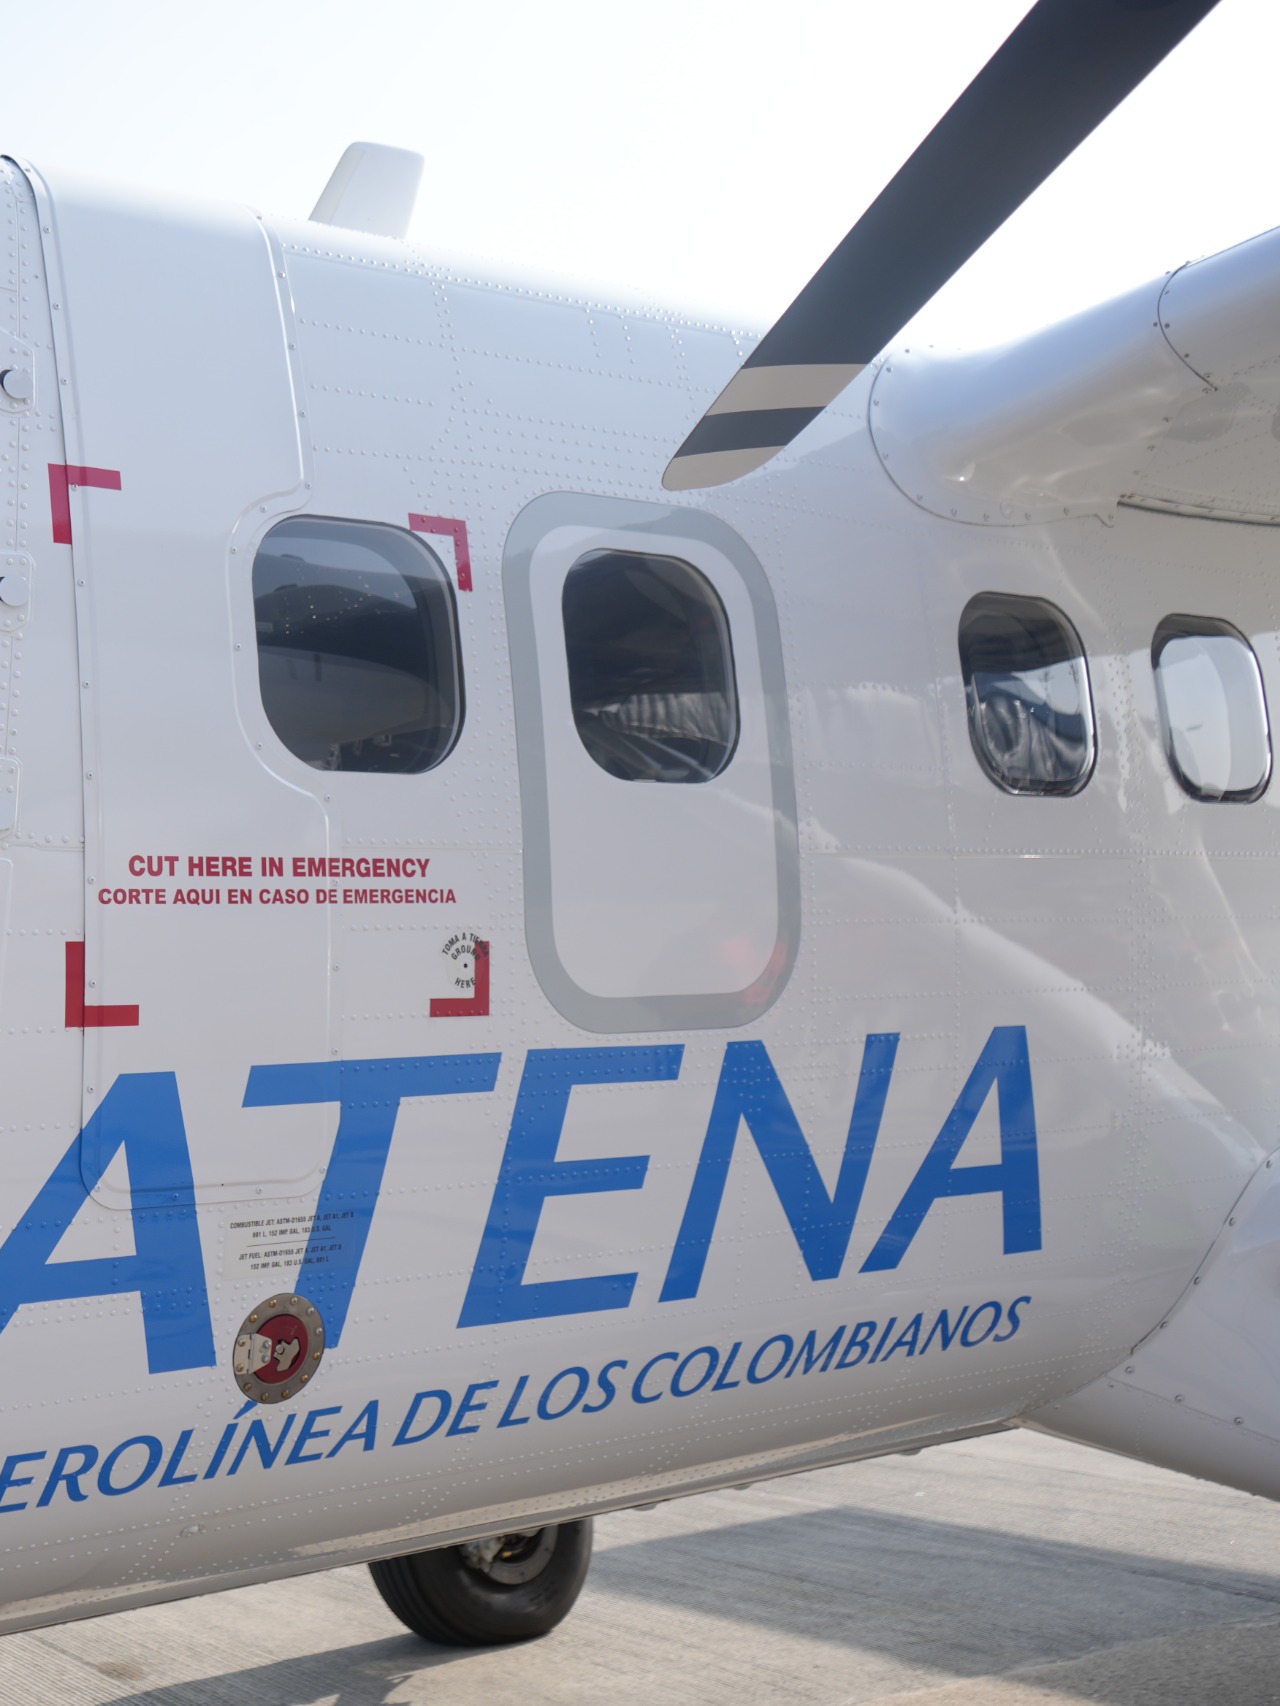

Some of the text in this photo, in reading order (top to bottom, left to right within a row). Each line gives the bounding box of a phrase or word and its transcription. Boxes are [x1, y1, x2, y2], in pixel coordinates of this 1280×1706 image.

[128, 855, 430, 878] CUT HERE IN EMERGENCY
[98, 888, 456, 906] CORTE AQUI EN CASO DE EMERGENCIA
[442, 934, 460, 955] TOMA
[462, 932, 466, 940] A
[451, 944, 481, 960] GROUND
[454, 977, 476, 988] HERE
[230, 1220, 264, 1229] COMBUSTIBLE
[391, 1380, 499, 1447] DE
[496, 1359, 628, 1429] LOS
[631, 1295, 1032, 1404] COLOMBIANOS
